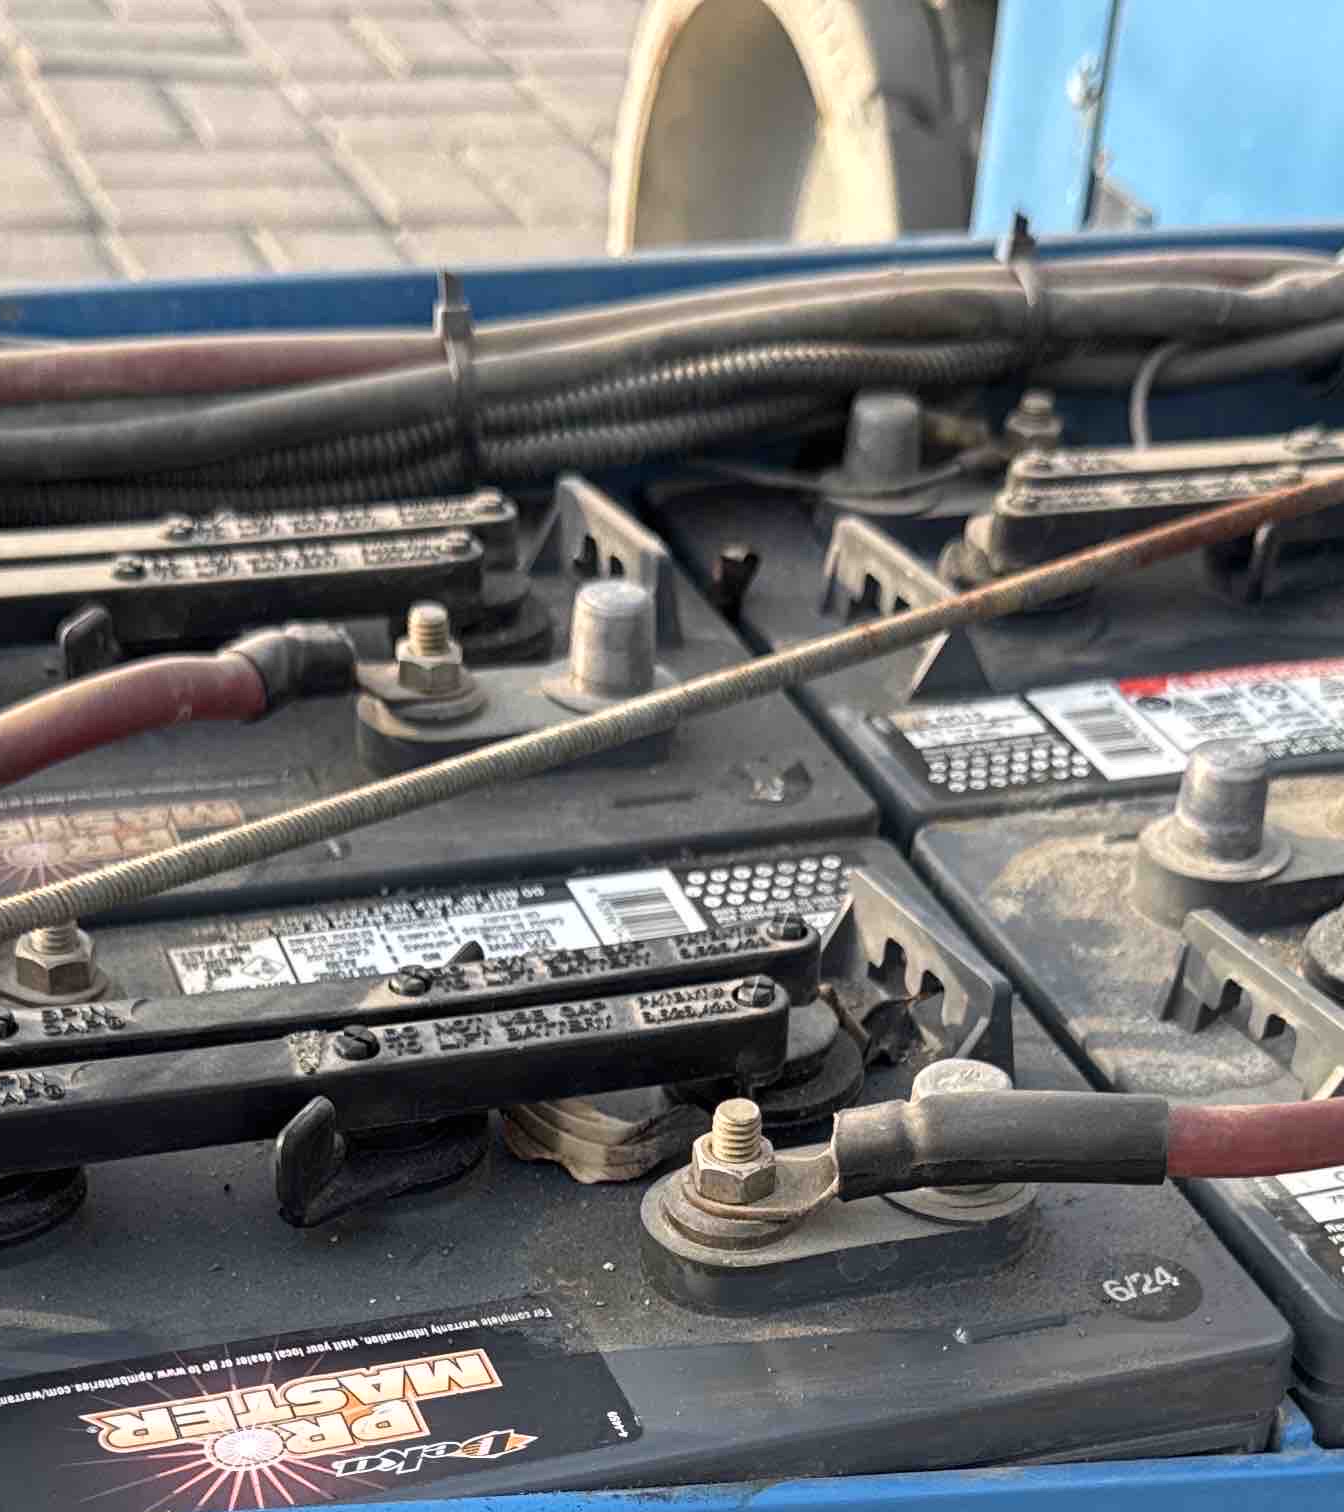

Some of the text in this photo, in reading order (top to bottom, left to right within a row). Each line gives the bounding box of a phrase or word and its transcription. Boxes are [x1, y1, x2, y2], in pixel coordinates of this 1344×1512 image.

[1100, 1263, 1181, 1304] 6/24
[479, 1308, 531, 1327] complete
[531, 1306, 552, 1319] For
[429, 1315, 479, 1335] warranty
[331, 1336, 360, 1350] visit
[359, 1324, 429, 1346] information,
[273, 1345, 304, 1360] local
[304, 1338, 331, 1353] your
[201, 1358, 217, 1372] go
[219, 1357, 232, 1369] or
[234, 1350, 272, 1367] dealer
[186, 1363, 200, 1375] to
[79, 1348, 504, 1453] MASTER
[204, 1392, 428, 1471] PRO
[329, 1426, 525, 1483] Deka
